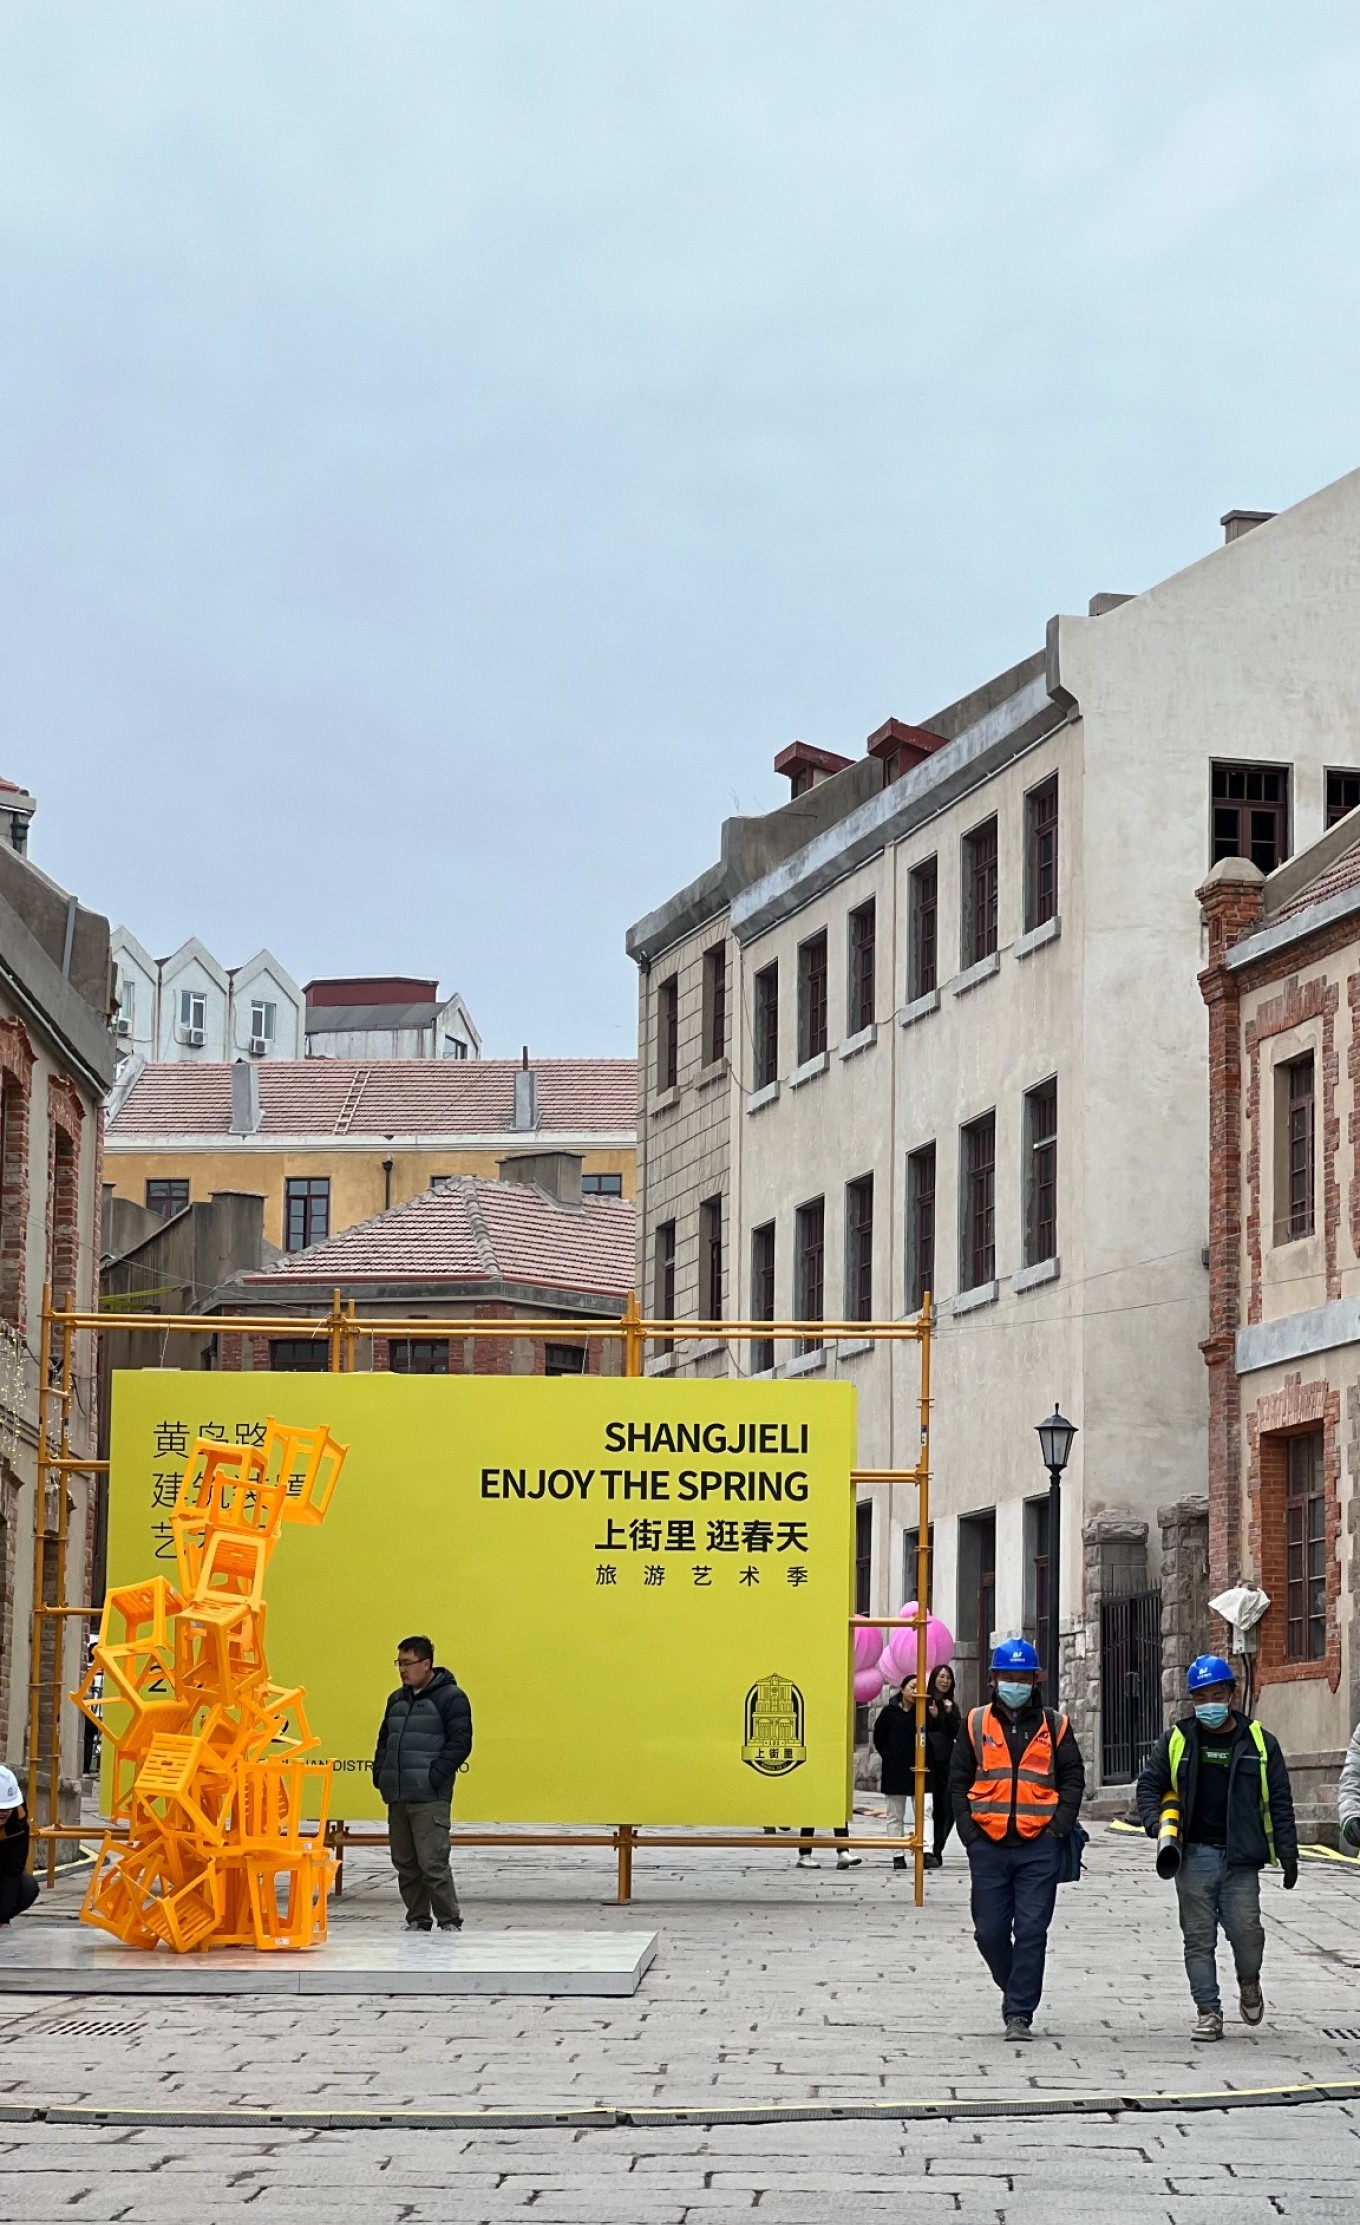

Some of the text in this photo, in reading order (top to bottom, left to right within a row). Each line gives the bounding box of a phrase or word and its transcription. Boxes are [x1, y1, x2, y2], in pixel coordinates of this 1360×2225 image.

[604, 1422, 809, 1454] SHANGJIELI
[481, 1468, 809, 1502] ENJOY THE SPRING
[594, 1518, 809, 1553] 上街里 逛春天
[595, 1563, 809, 1588] 旅游艺术季
